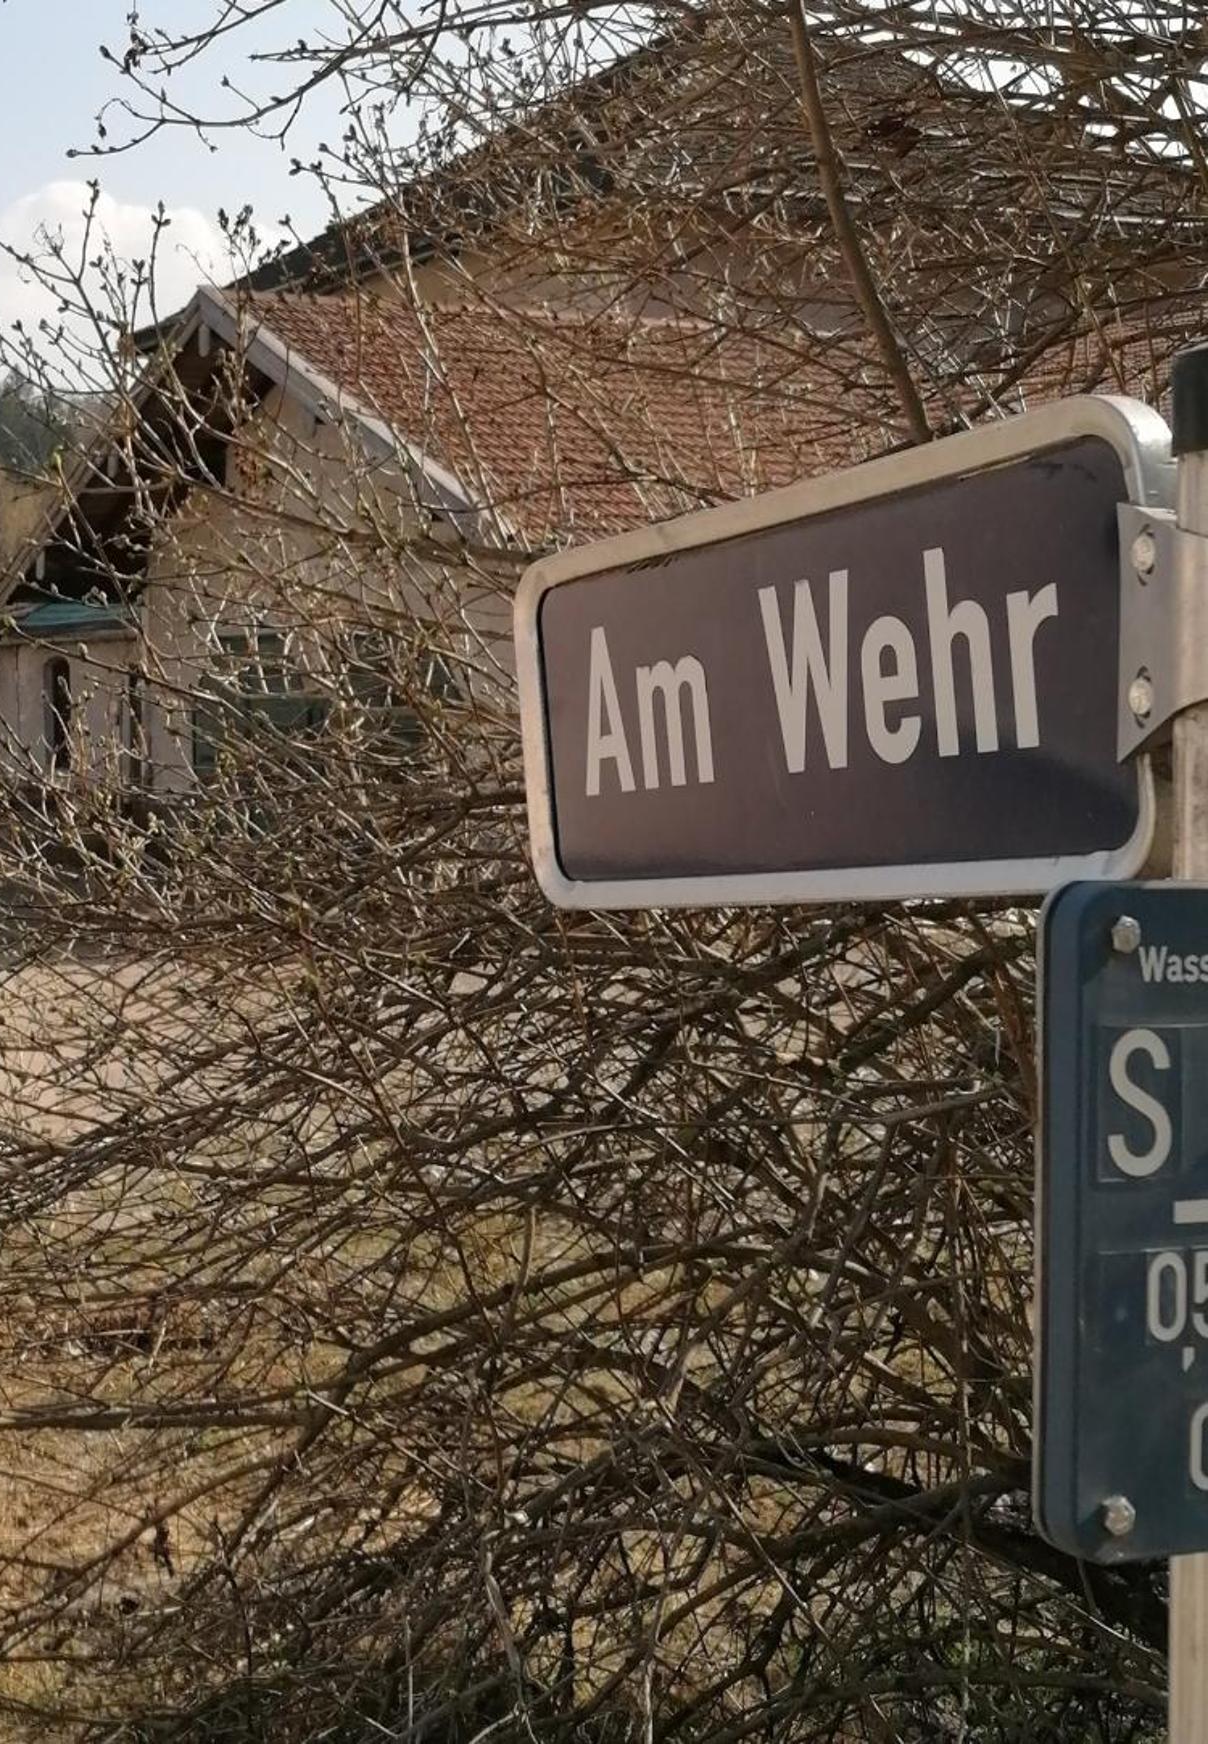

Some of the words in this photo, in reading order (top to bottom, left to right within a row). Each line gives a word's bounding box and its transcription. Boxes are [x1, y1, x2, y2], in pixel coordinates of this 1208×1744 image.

[585, 626, 715, 796] Am
[757, 547, 1059, 774] Wehr
[1107, 1028, 1173, 1177] S
